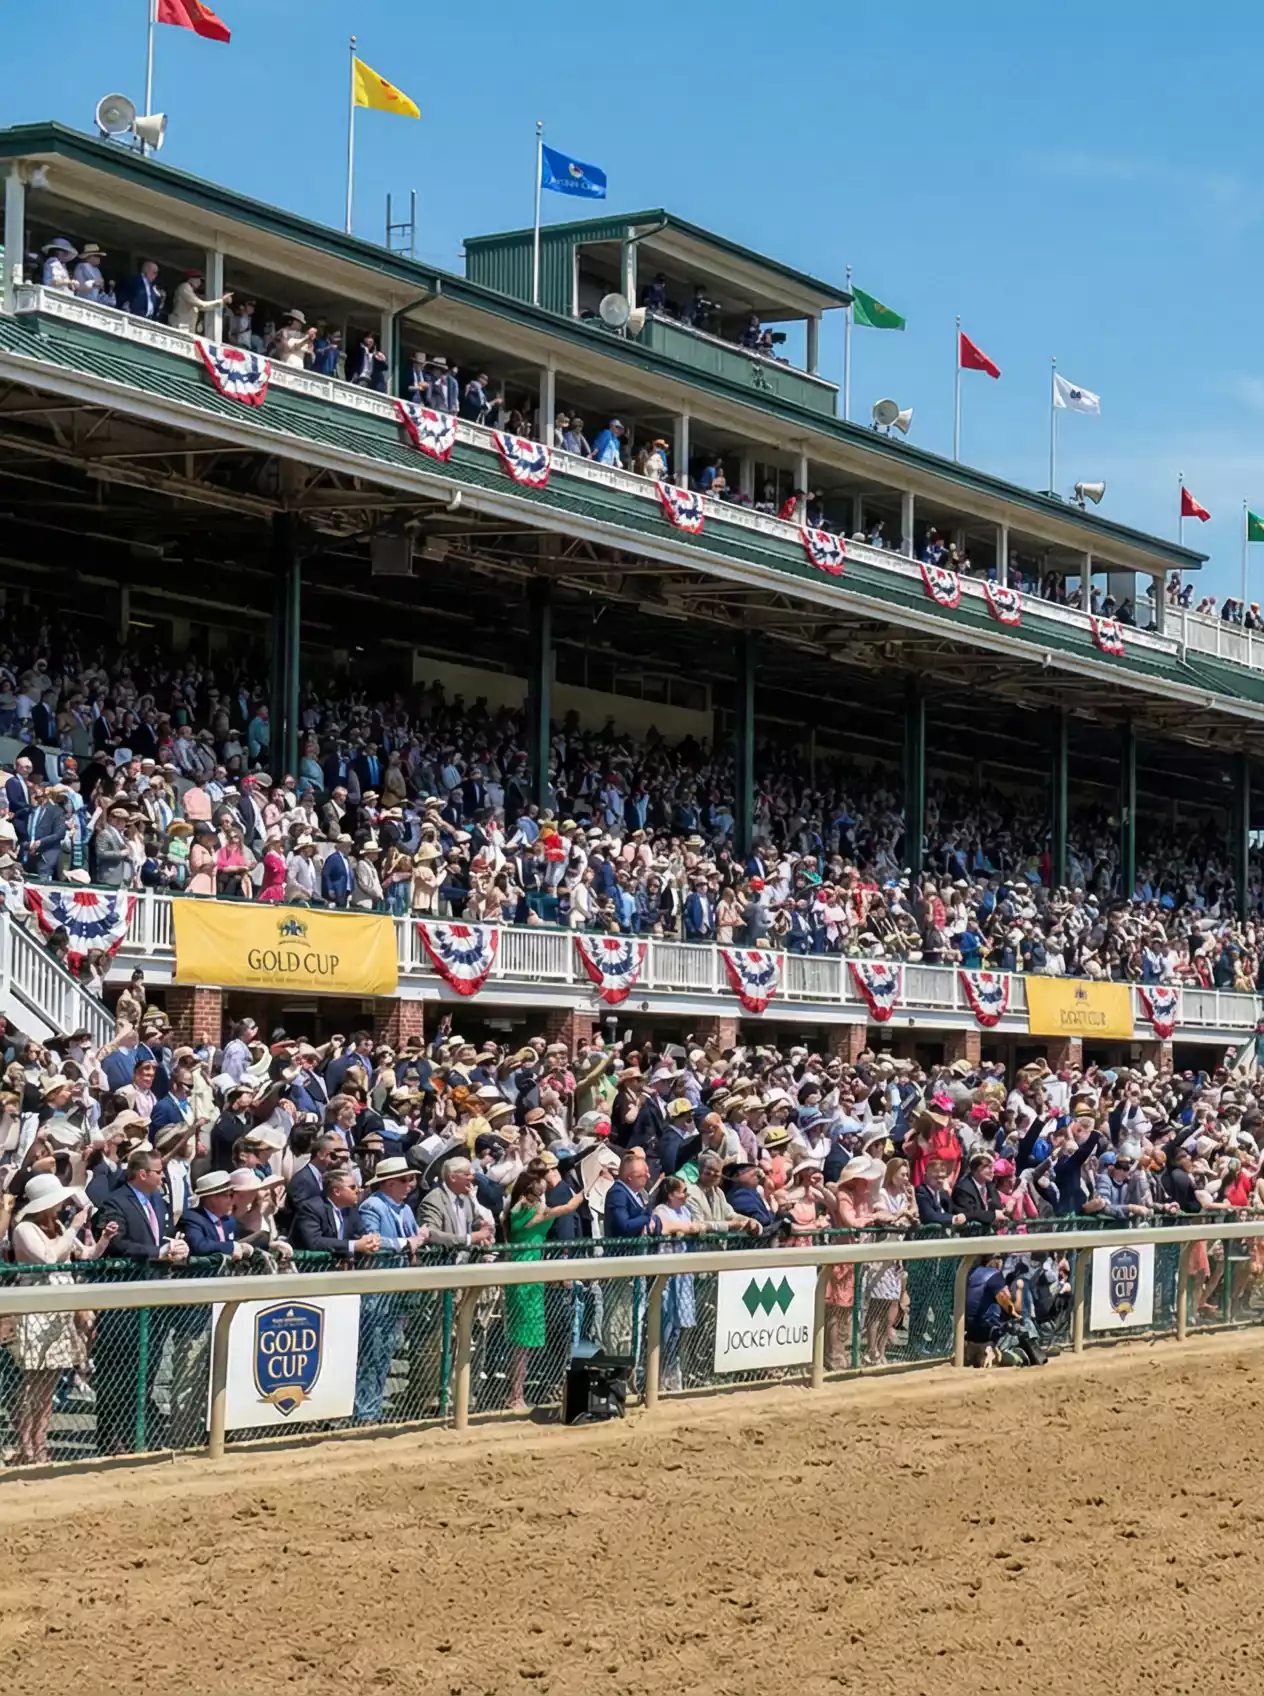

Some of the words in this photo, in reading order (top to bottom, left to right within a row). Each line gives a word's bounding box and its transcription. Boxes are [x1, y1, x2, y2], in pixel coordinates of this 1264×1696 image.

[247, 948, 300, 973] GOLD
[303, 952, 340, 976] CUP
[260, 1328, 318, 1355] GOLD
[723, 1328, 775, 1355] JOCKEY
[775, 1324, 809, 1346] CLUB
[267, 1354, 308, 1379] CUP
